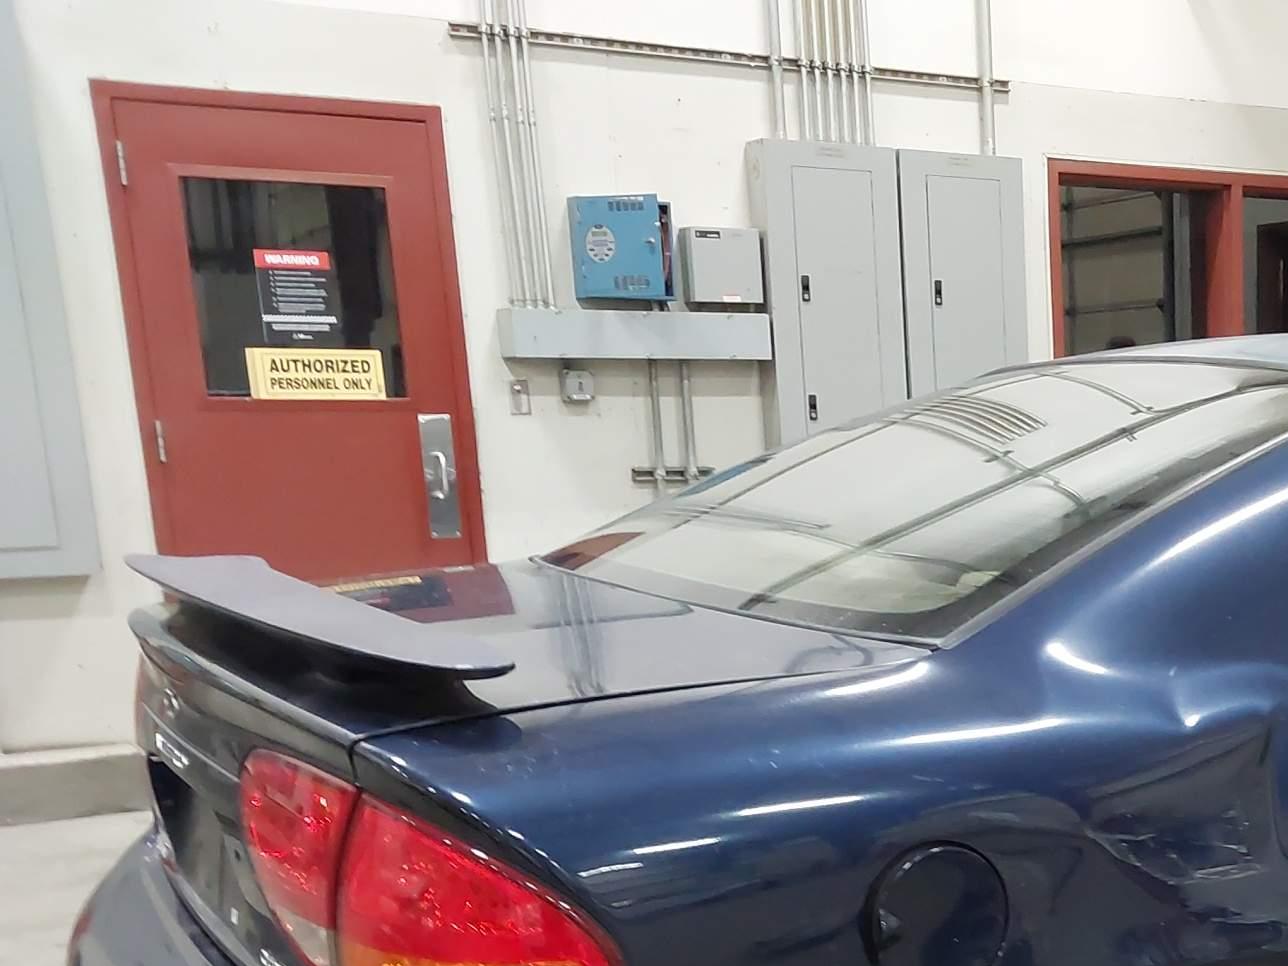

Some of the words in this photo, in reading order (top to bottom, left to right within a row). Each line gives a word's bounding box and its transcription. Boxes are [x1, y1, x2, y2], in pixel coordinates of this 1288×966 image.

[264, 253, 320, 266] WARNING
[269, 358, 371, 374] AUTHORIZED
[270, 377, 339, 390] PERSONNEL
[343, 378, 373, 391] ONLY
